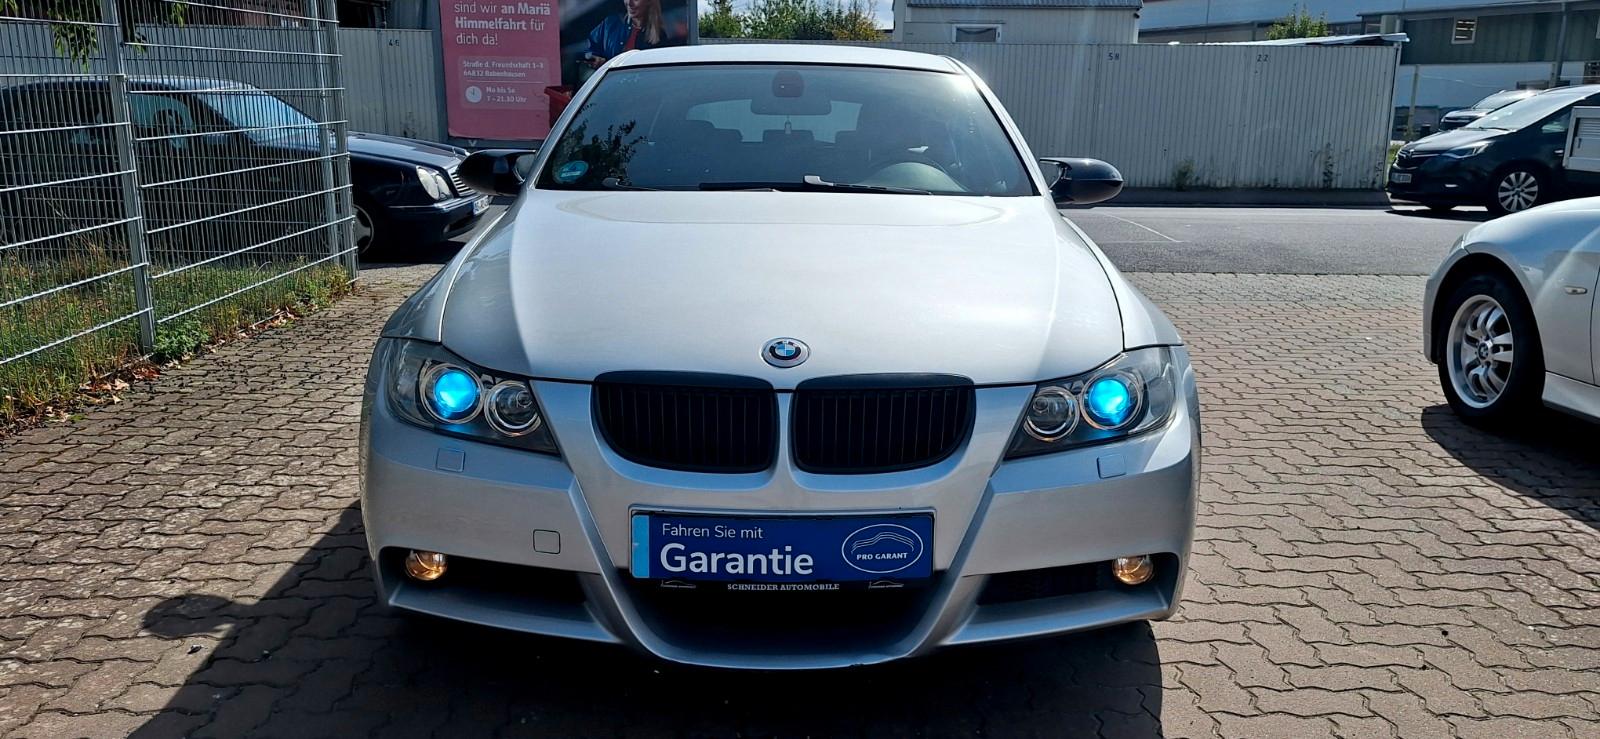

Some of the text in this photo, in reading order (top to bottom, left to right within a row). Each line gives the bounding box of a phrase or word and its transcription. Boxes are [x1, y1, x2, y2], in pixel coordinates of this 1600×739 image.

[454, 2, 550, 15] sind wir an Mariä
[455, 17, 545, 31] Himmelfahrt für
[457, 33, 498, 45] dich da!
[662, 523, 764, 539] Fahren Sie mit
[660, 543, 814, 575] Garantie
[875, 552, 908, 560] GARANT
[727, 583, 778, 591] SCHNEIDER
